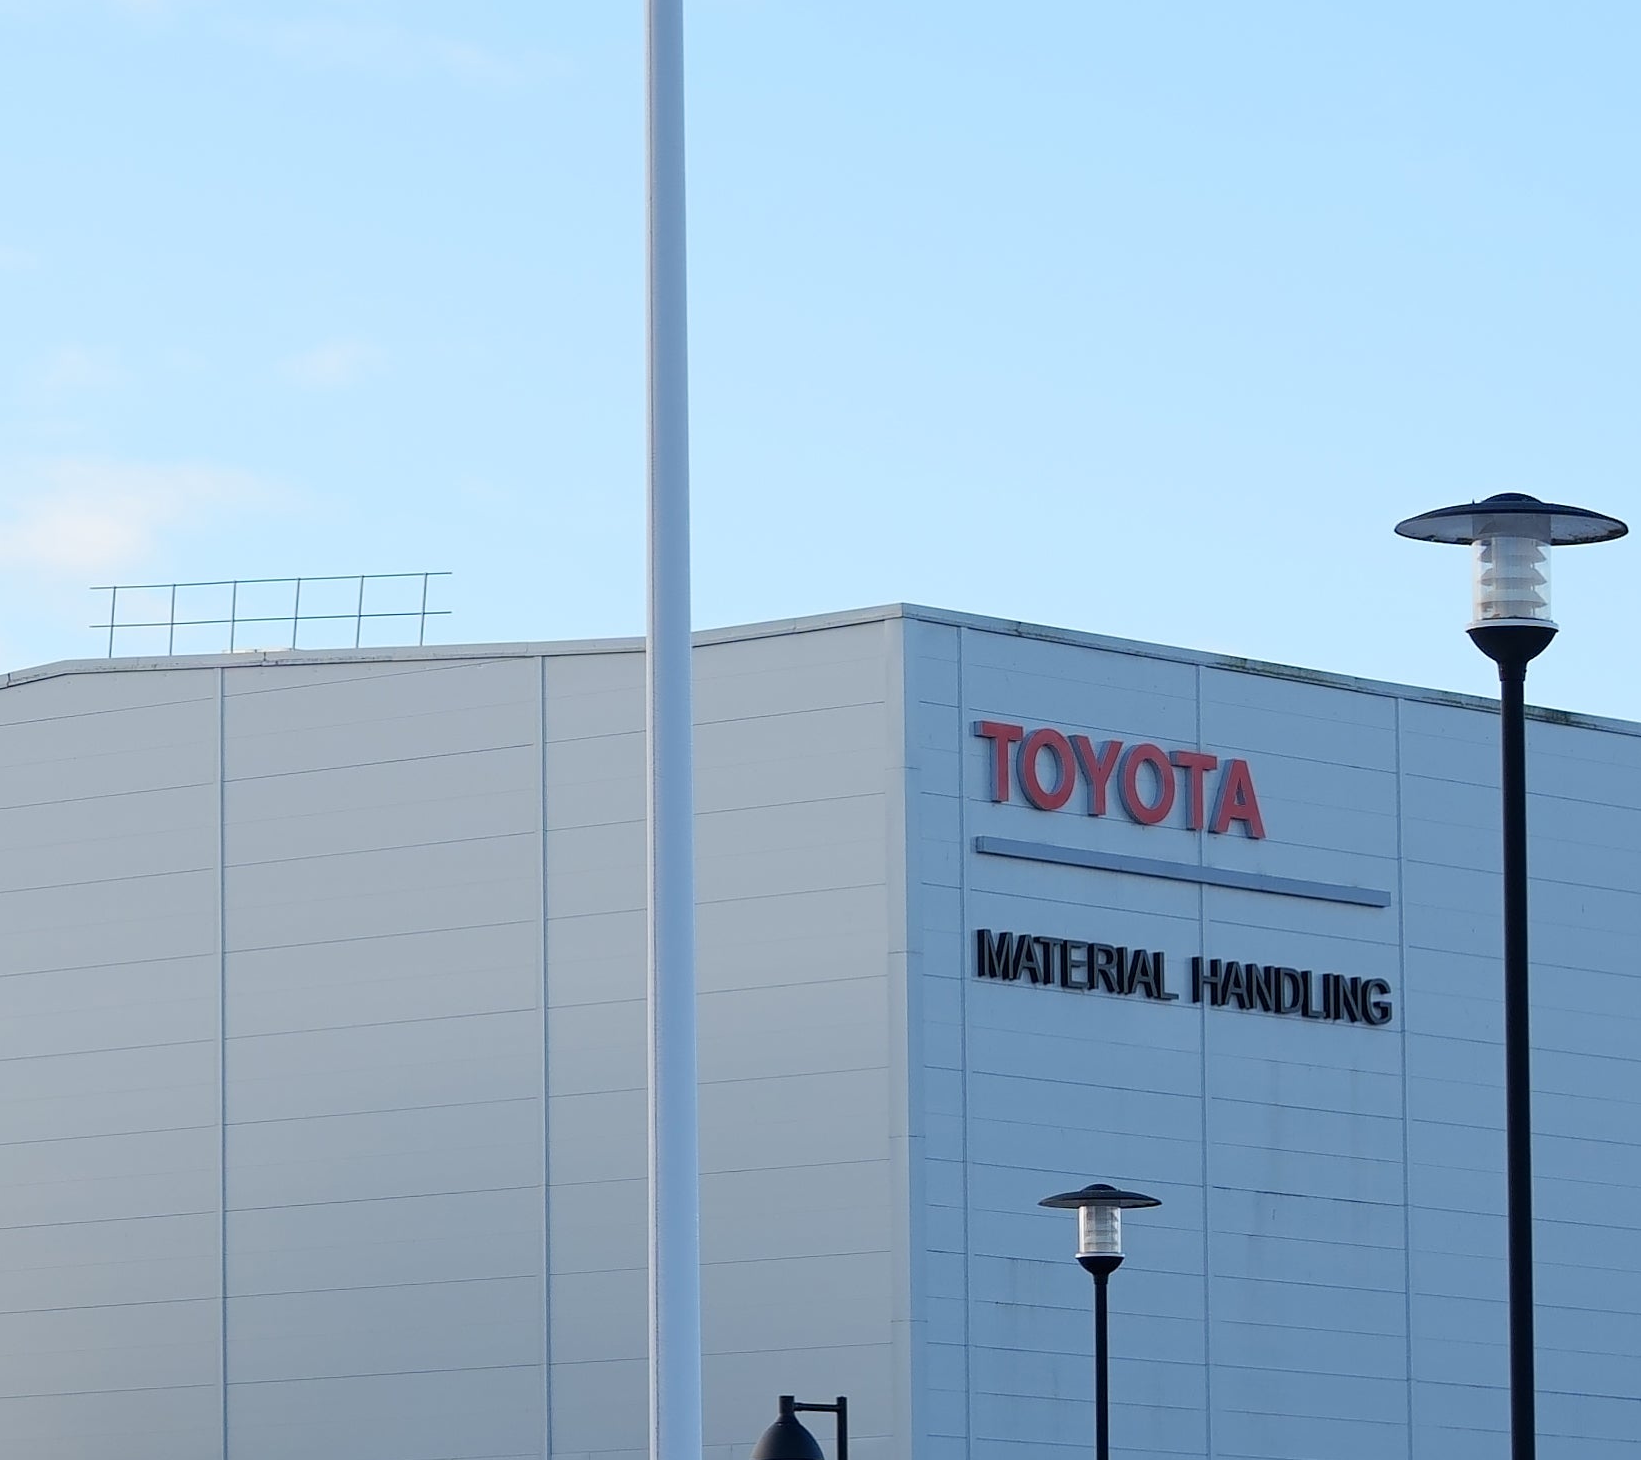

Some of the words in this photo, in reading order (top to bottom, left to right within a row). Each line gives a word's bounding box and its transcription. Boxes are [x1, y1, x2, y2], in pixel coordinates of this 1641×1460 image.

[974, 719, 1266, 840] TOYOTA
[976, 928, 1179, 1001] MATERIAL
[1191, 955, 1393, 1026] HANDLING
